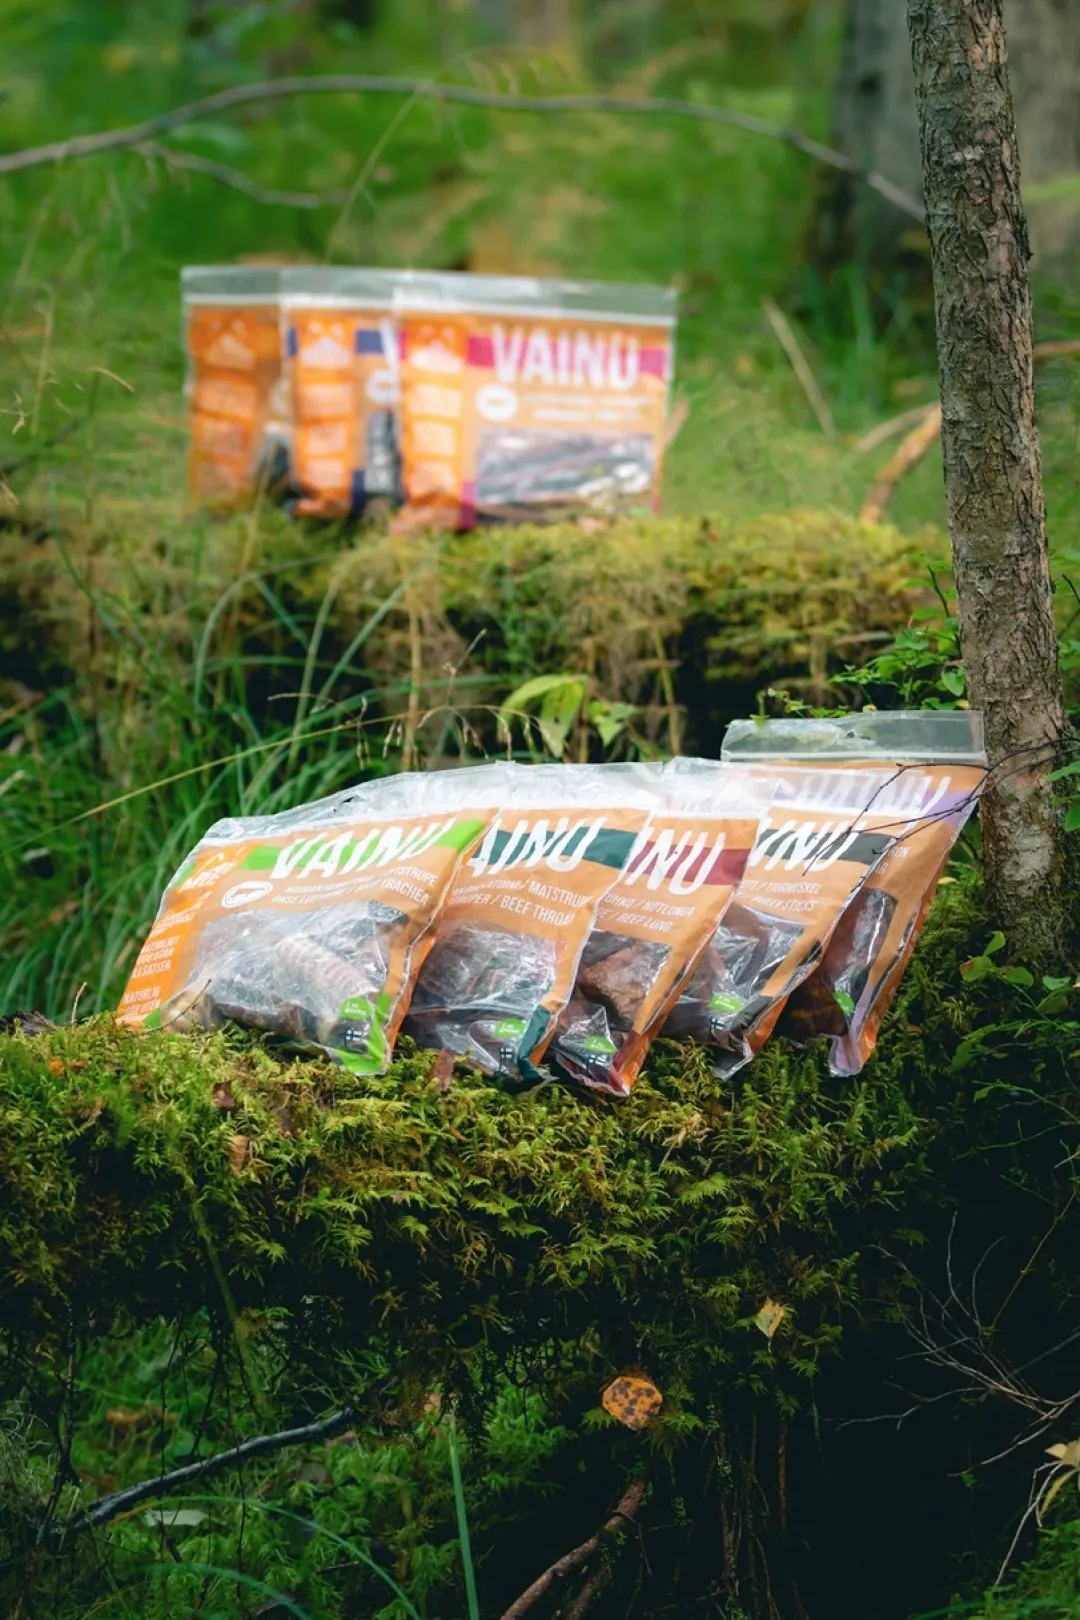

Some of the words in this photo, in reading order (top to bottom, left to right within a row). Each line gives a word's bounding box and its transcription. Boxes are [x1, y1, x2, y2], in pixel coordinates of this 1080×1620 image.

[493, 324, 641, 391] VAINU
[268, 817, 457, 879] VAINU
[465, 817, 608, 877] AINU
[622, 826, 727, 895] INU
[748, 818, 868, 872] INU
[500, 895, 532, 915] BEEF
